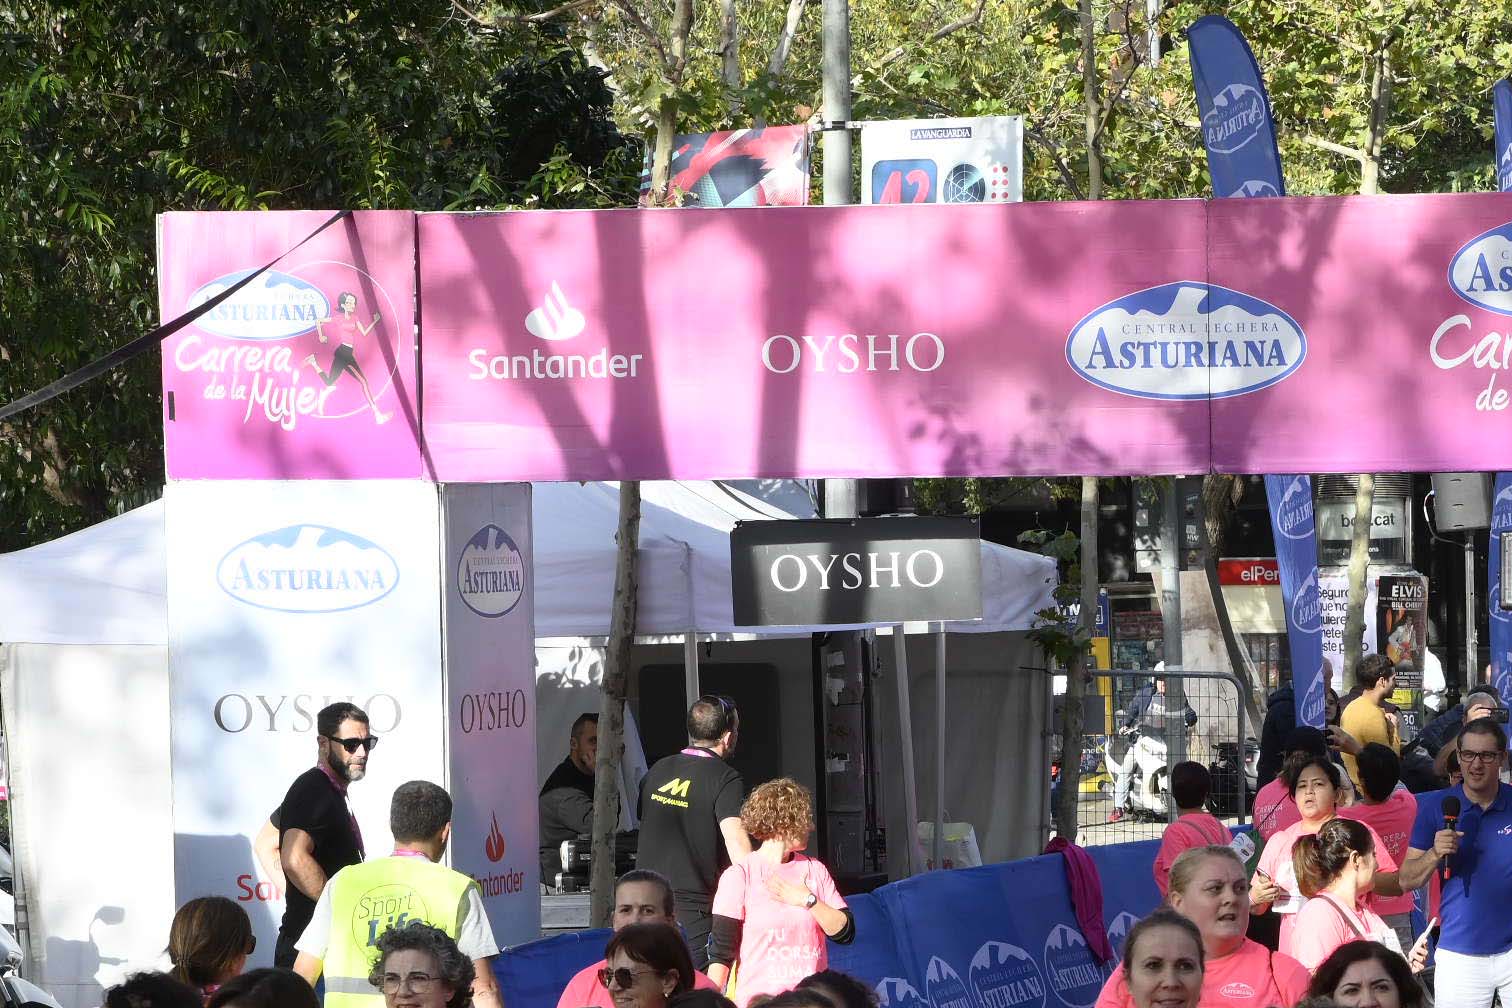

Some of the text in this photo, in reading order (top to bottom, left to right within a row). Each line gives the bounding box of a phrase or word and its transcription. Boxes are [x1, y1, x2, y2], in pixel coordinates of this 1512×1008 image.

[1084, 325, 1288, 371] ASTURIANA
[1122, 322, 1195, 336] CENTRAL
[175, 335, 294, 373] Carrera
[469, 347, 643, 379] Santander
[761, 332, 945, 375] OYSHO
[204, 370, 337, 431] de la Mujer
[1476, 374, 1509, 412] de
[231, 557, 386, 592] ASTURIANA
[462, 564, 521, 596] ASTURIANA
[769, 548, 944, 593] OYSHO
[1241, 566, 1279, 582] elPer
[1391, 584, 1422, 598] ELVIS
[213, 693, 402, 734] OYSO
[460, 688, 527, 735] OYSHO
